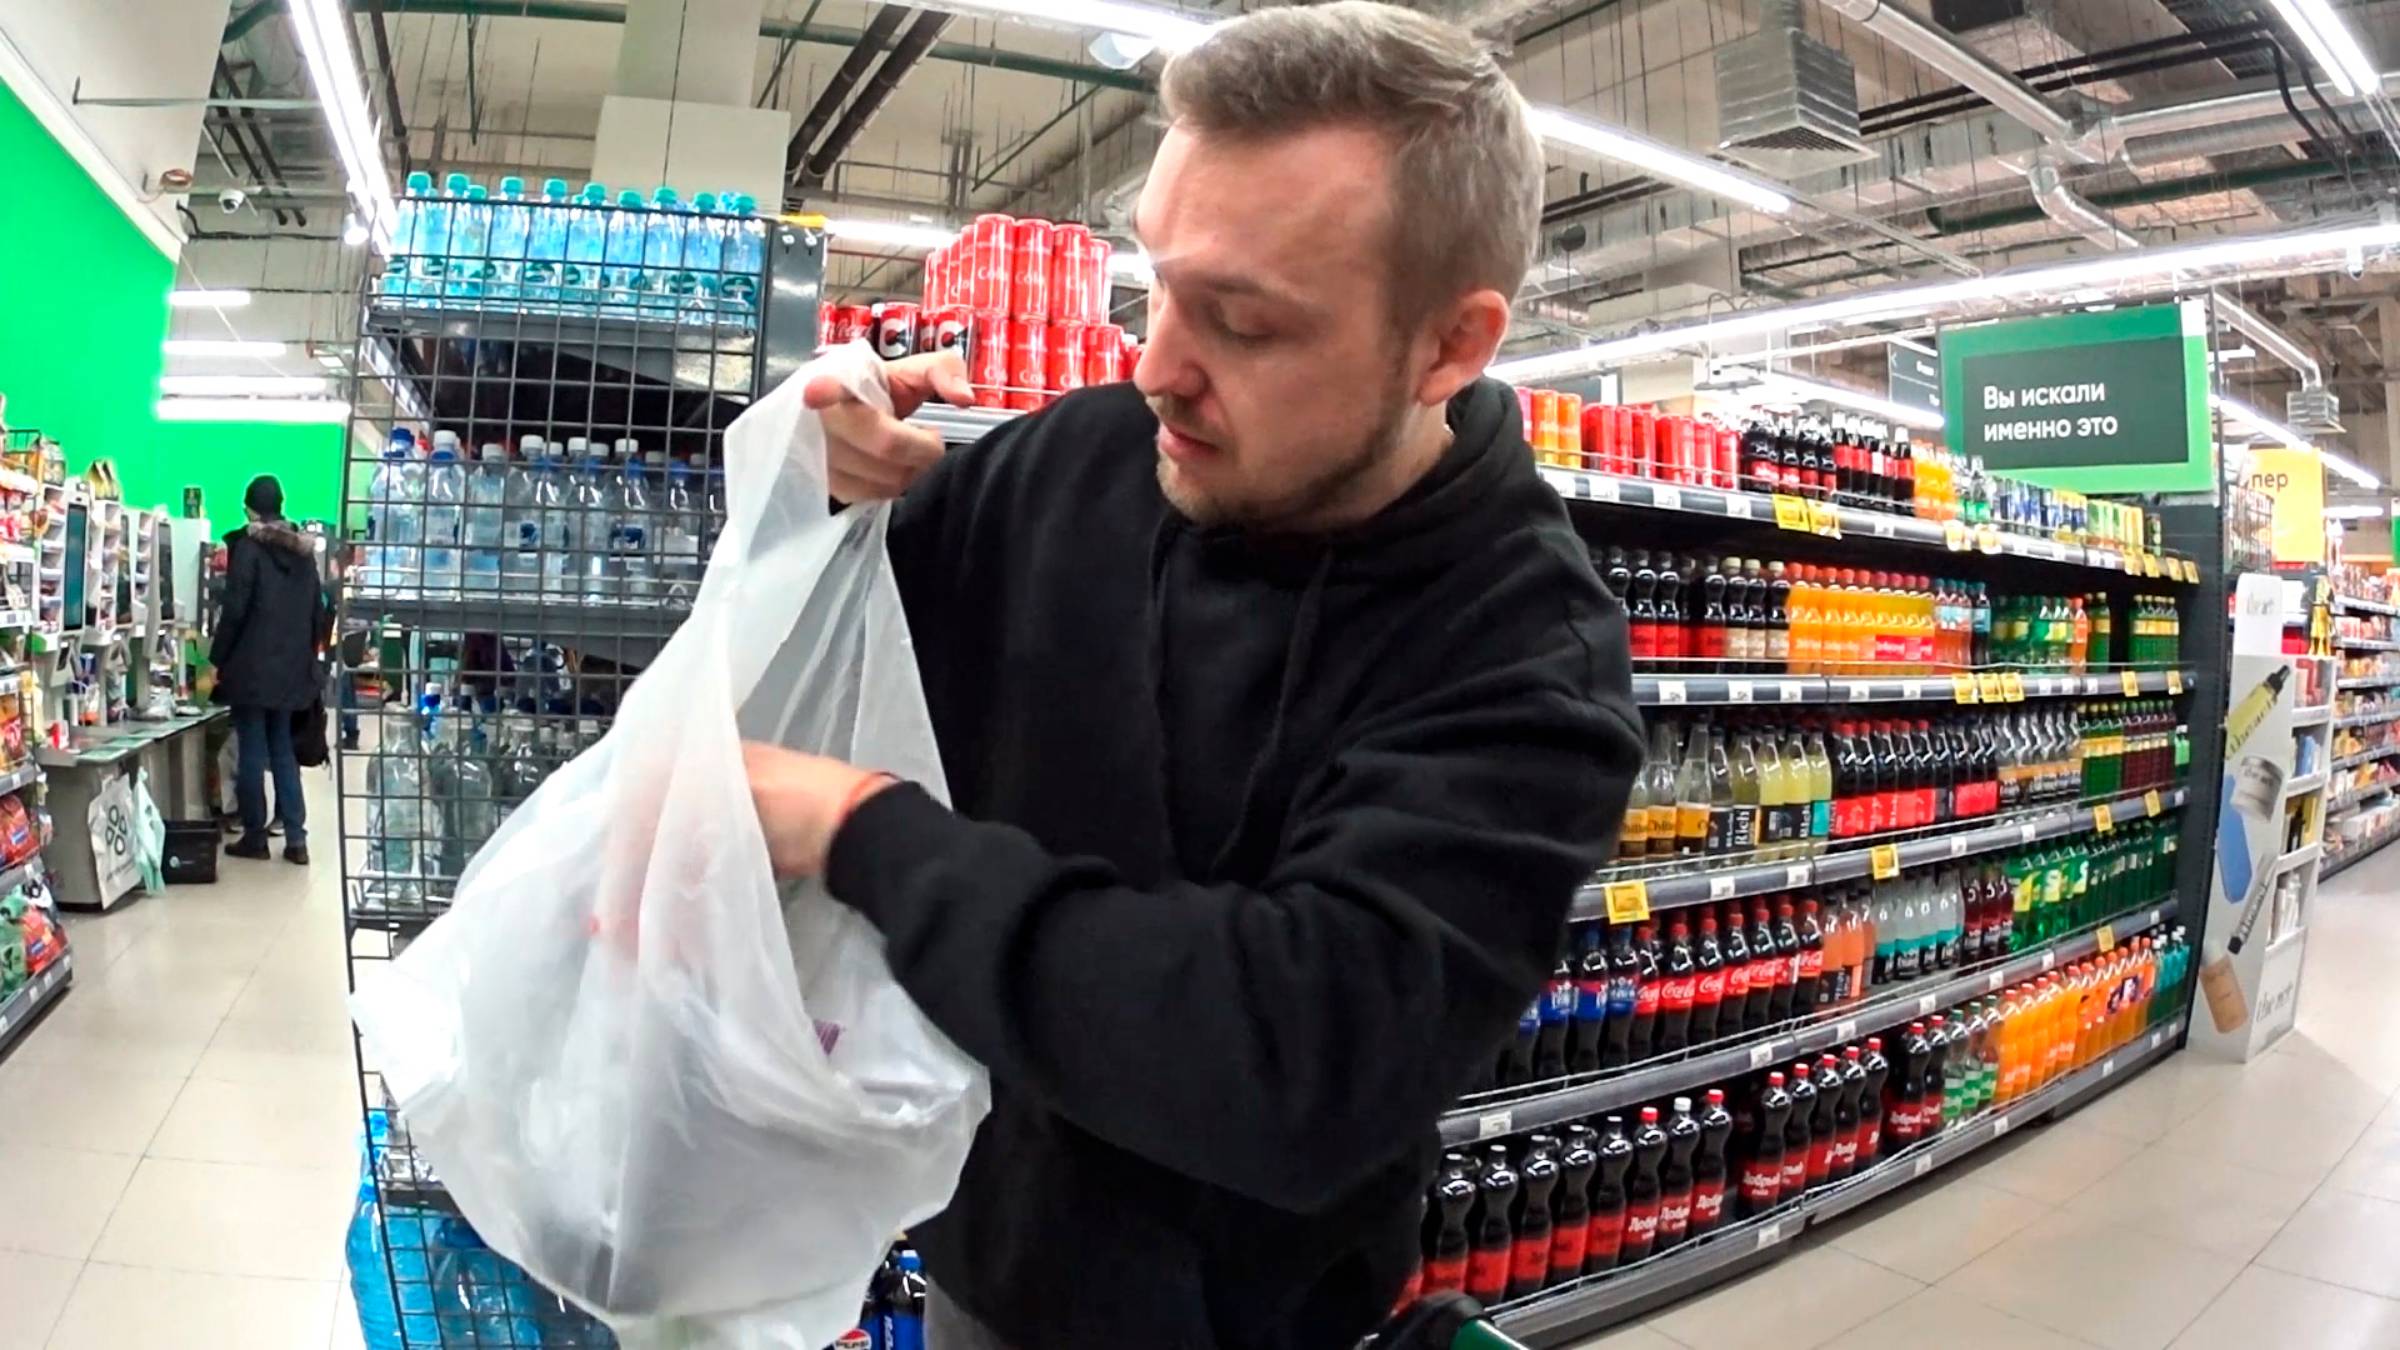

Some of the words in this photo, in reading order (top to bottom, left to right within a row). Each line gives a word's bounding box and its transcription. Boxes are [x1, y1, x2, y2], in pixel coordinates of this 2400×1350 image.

[1984, 385, 2015, 410] Вы
[2021, 382, 2105, 407] искали
[1984, 417, 2072, 443] именно
[2077, 415, 2118, 437] это
[1734, 810, 1751, 846] Rich
